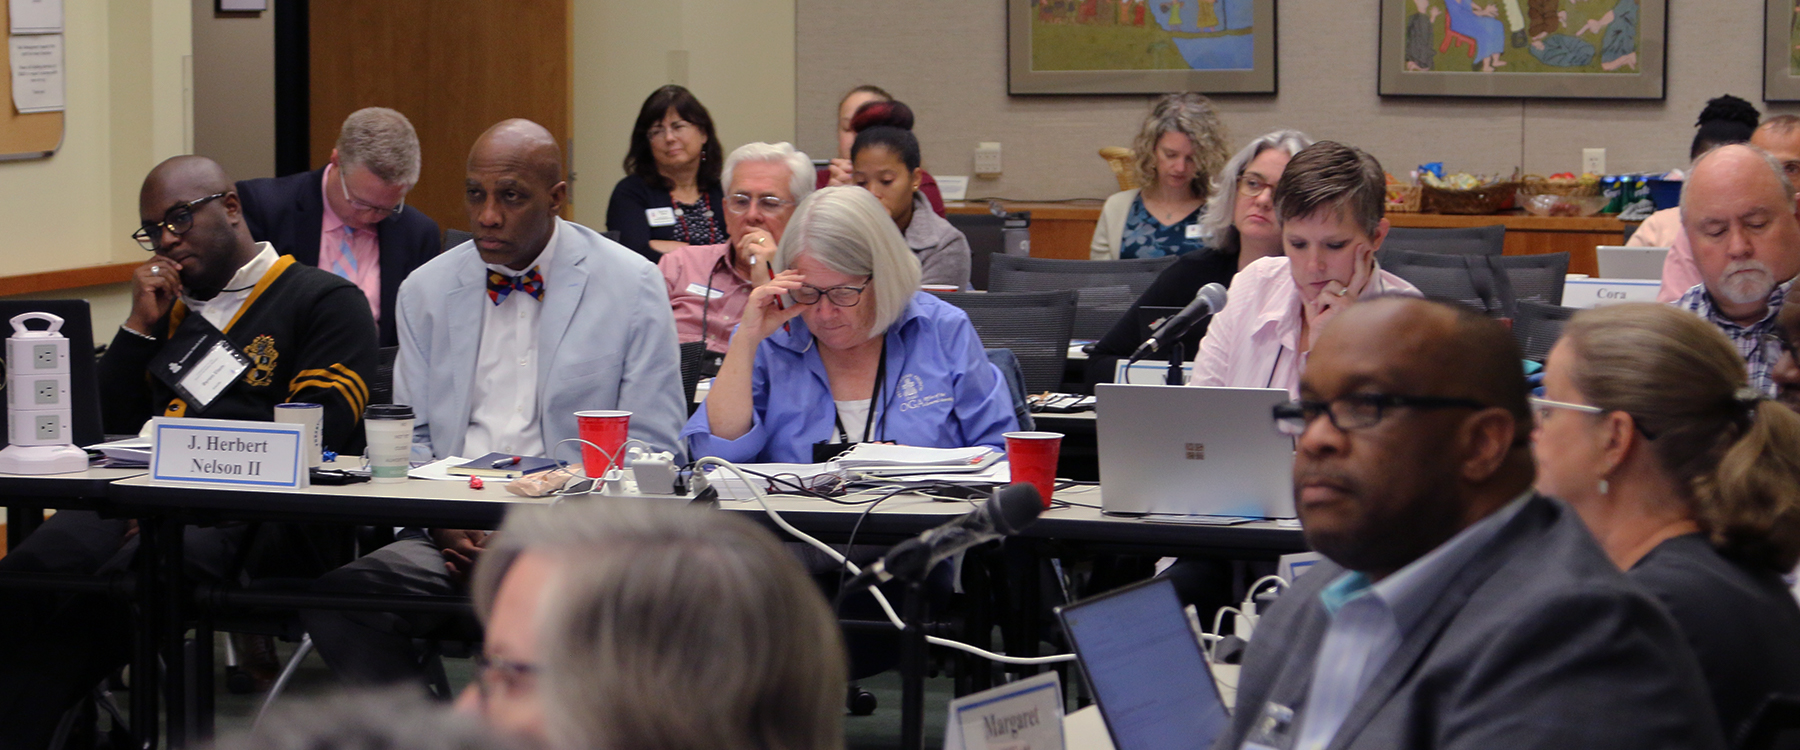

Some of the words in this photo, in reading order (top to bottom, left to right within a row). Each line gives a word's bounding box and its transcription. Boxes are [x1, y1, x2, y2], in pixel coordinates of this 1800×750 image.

[1597, 288, 1627, 299] Cora
[900, 399, 923, 412] OGA
[187, 435, 201, 450] J.
[207, 436, 268, 453] Herbert
[190, 458, 242, 475] Nelson
[248, 461, 262, 476] II
[984, 706, 1039, 738] Margaret
